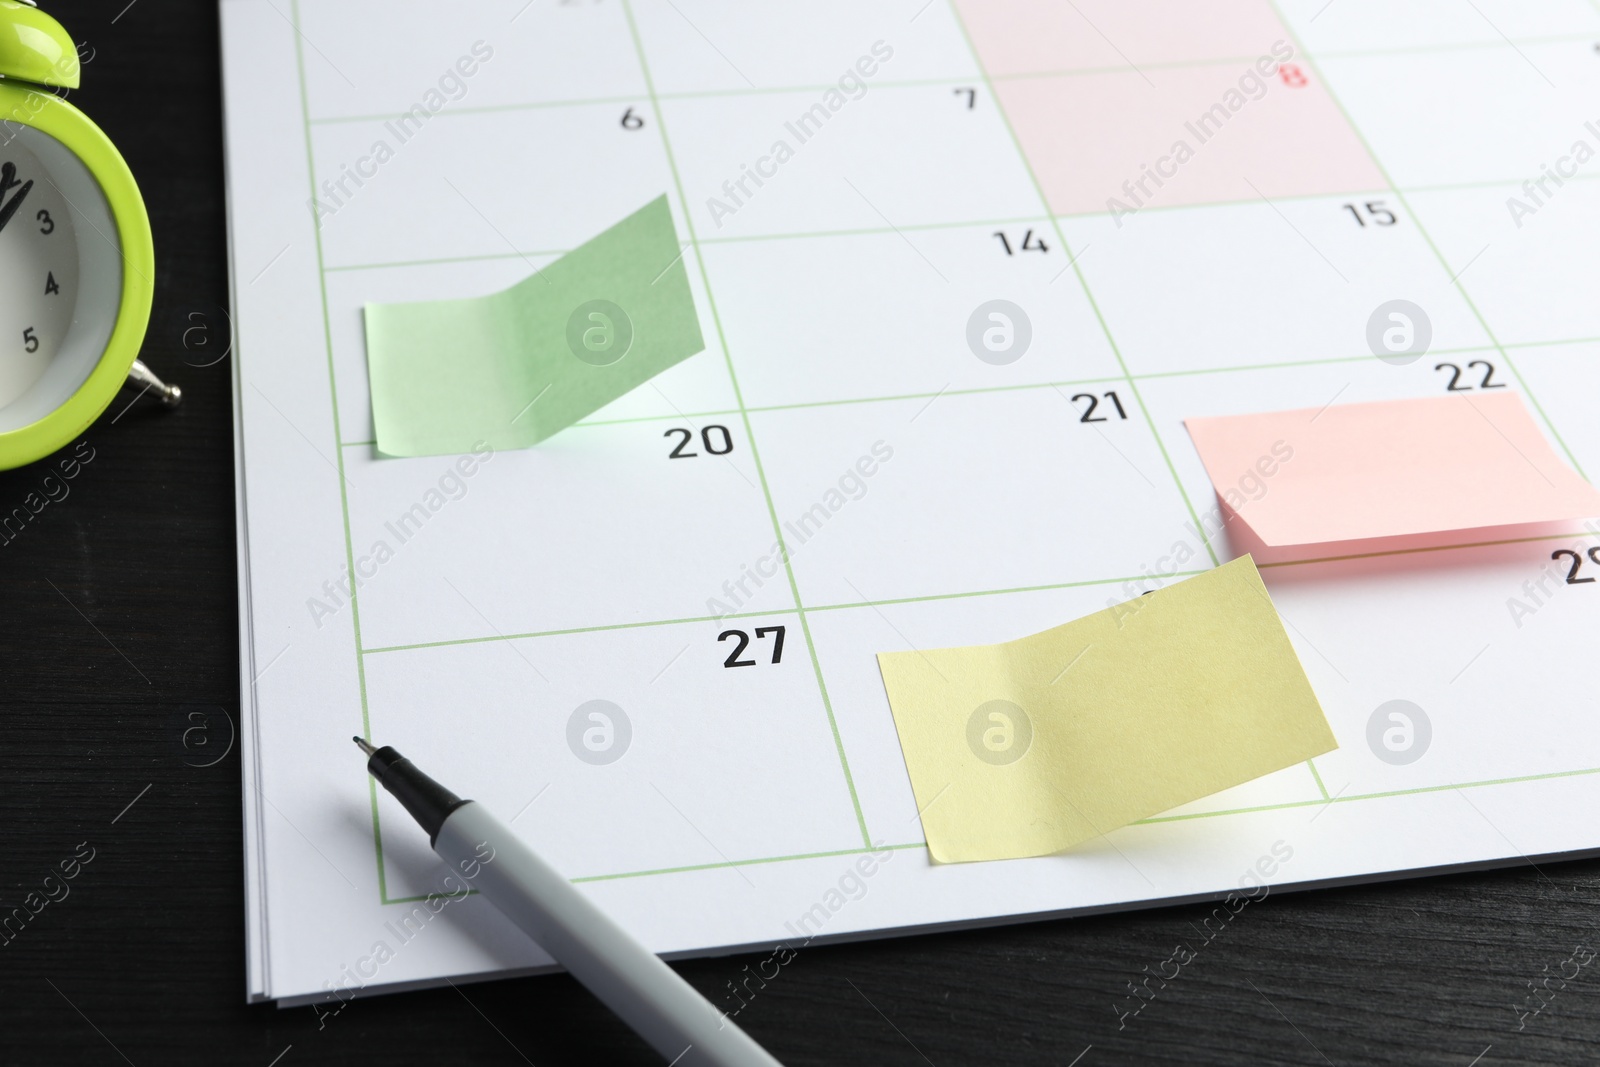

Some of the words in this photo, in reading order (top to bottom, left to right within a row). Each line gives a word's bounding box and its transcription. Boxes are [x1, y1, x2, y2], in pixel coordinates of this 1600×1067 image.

[1278, 64, 1309, 89] 8
[954, 87, 977, 110] 7
[620, 108, 645, 131] 6
[36, 209, 55, 236] 3
[1343, 201, 1398, 228] 15
[993, 228, 1050, 257] 14
[44, 271, 60, 296] 4
[22, 327, 40, 354] 5
[1434, 361, 1506, 392] 22
[1071, 391, 1128, 423] 21
[663, 424, 734, 459] 20
[717, 625, 786, 669] 27
